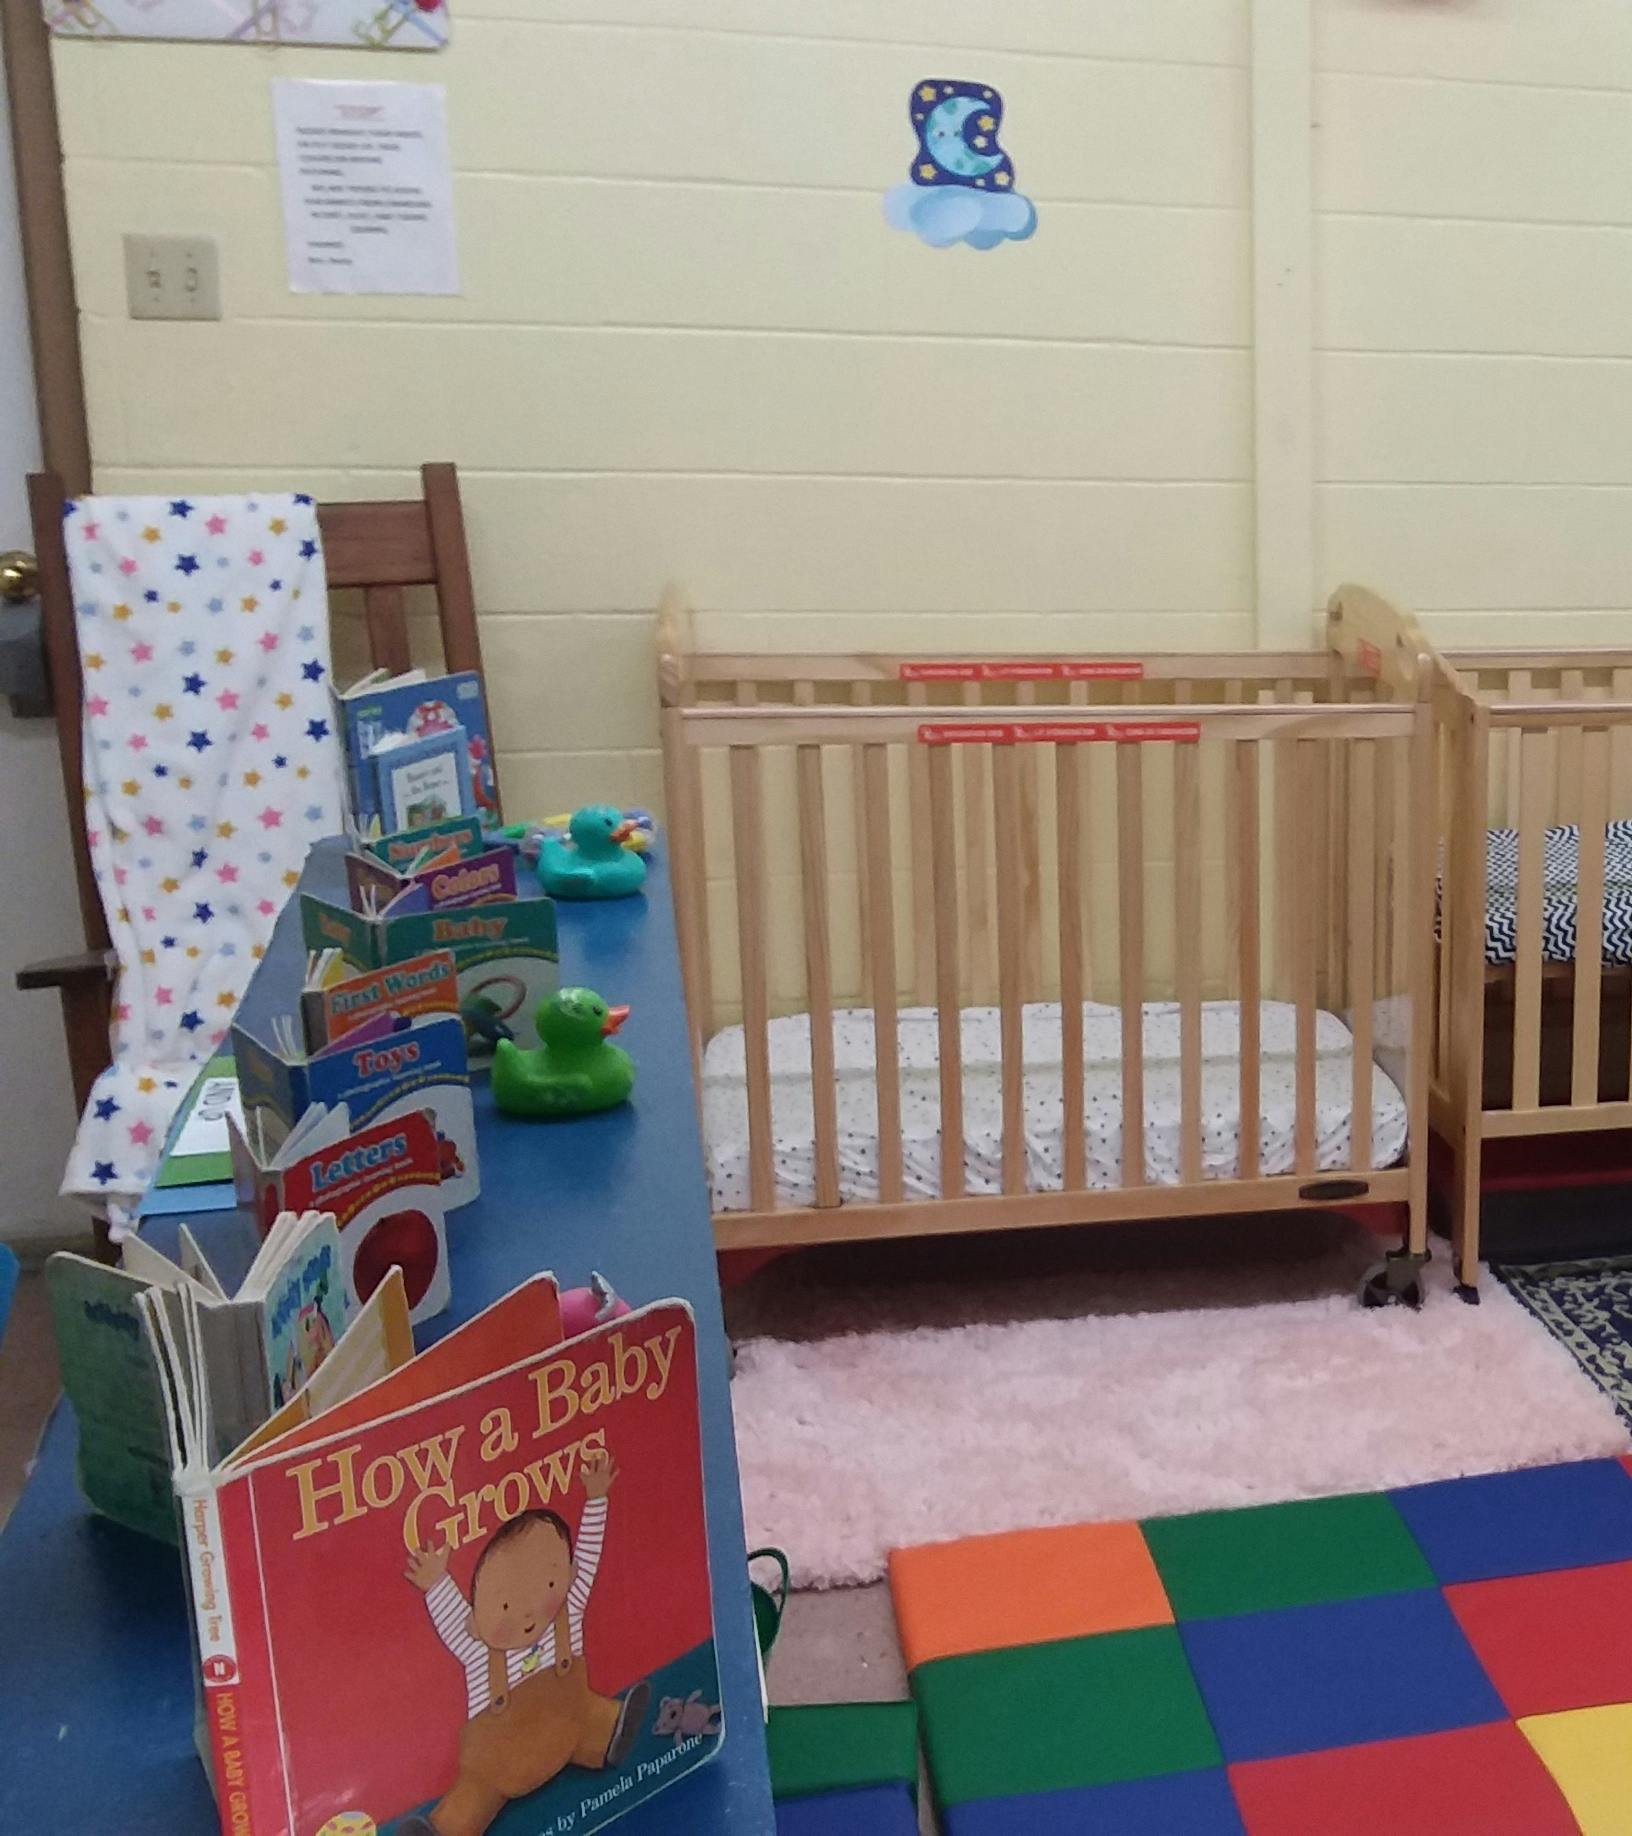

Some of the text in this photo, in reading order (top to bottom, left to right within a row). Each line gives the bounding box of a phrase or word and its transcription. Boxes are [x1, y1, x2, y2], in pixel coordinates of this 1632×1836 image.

[431, 863, 500, 899] Colors
[432, 916, 507, 941] Baby
[331, 985, 379, 1014] First
[385, 963, 449, 995] Words
[353, 1041, 420, 1078] Toys
[311, 1133, 407, 1193] Letters
[286, 1326, 682, 1541] How a Baby
[403, 1428, 609, 1557] Grows
[193, 1500, 223, 1642] Harper Growing Tree
[216, 1692, 237, 1731] HOW
[222, 1736, 240, 1748] A
[223, 1750, 245, 1786] BABY
[556, 1733, 702, 1832] by Pamela Paparone
